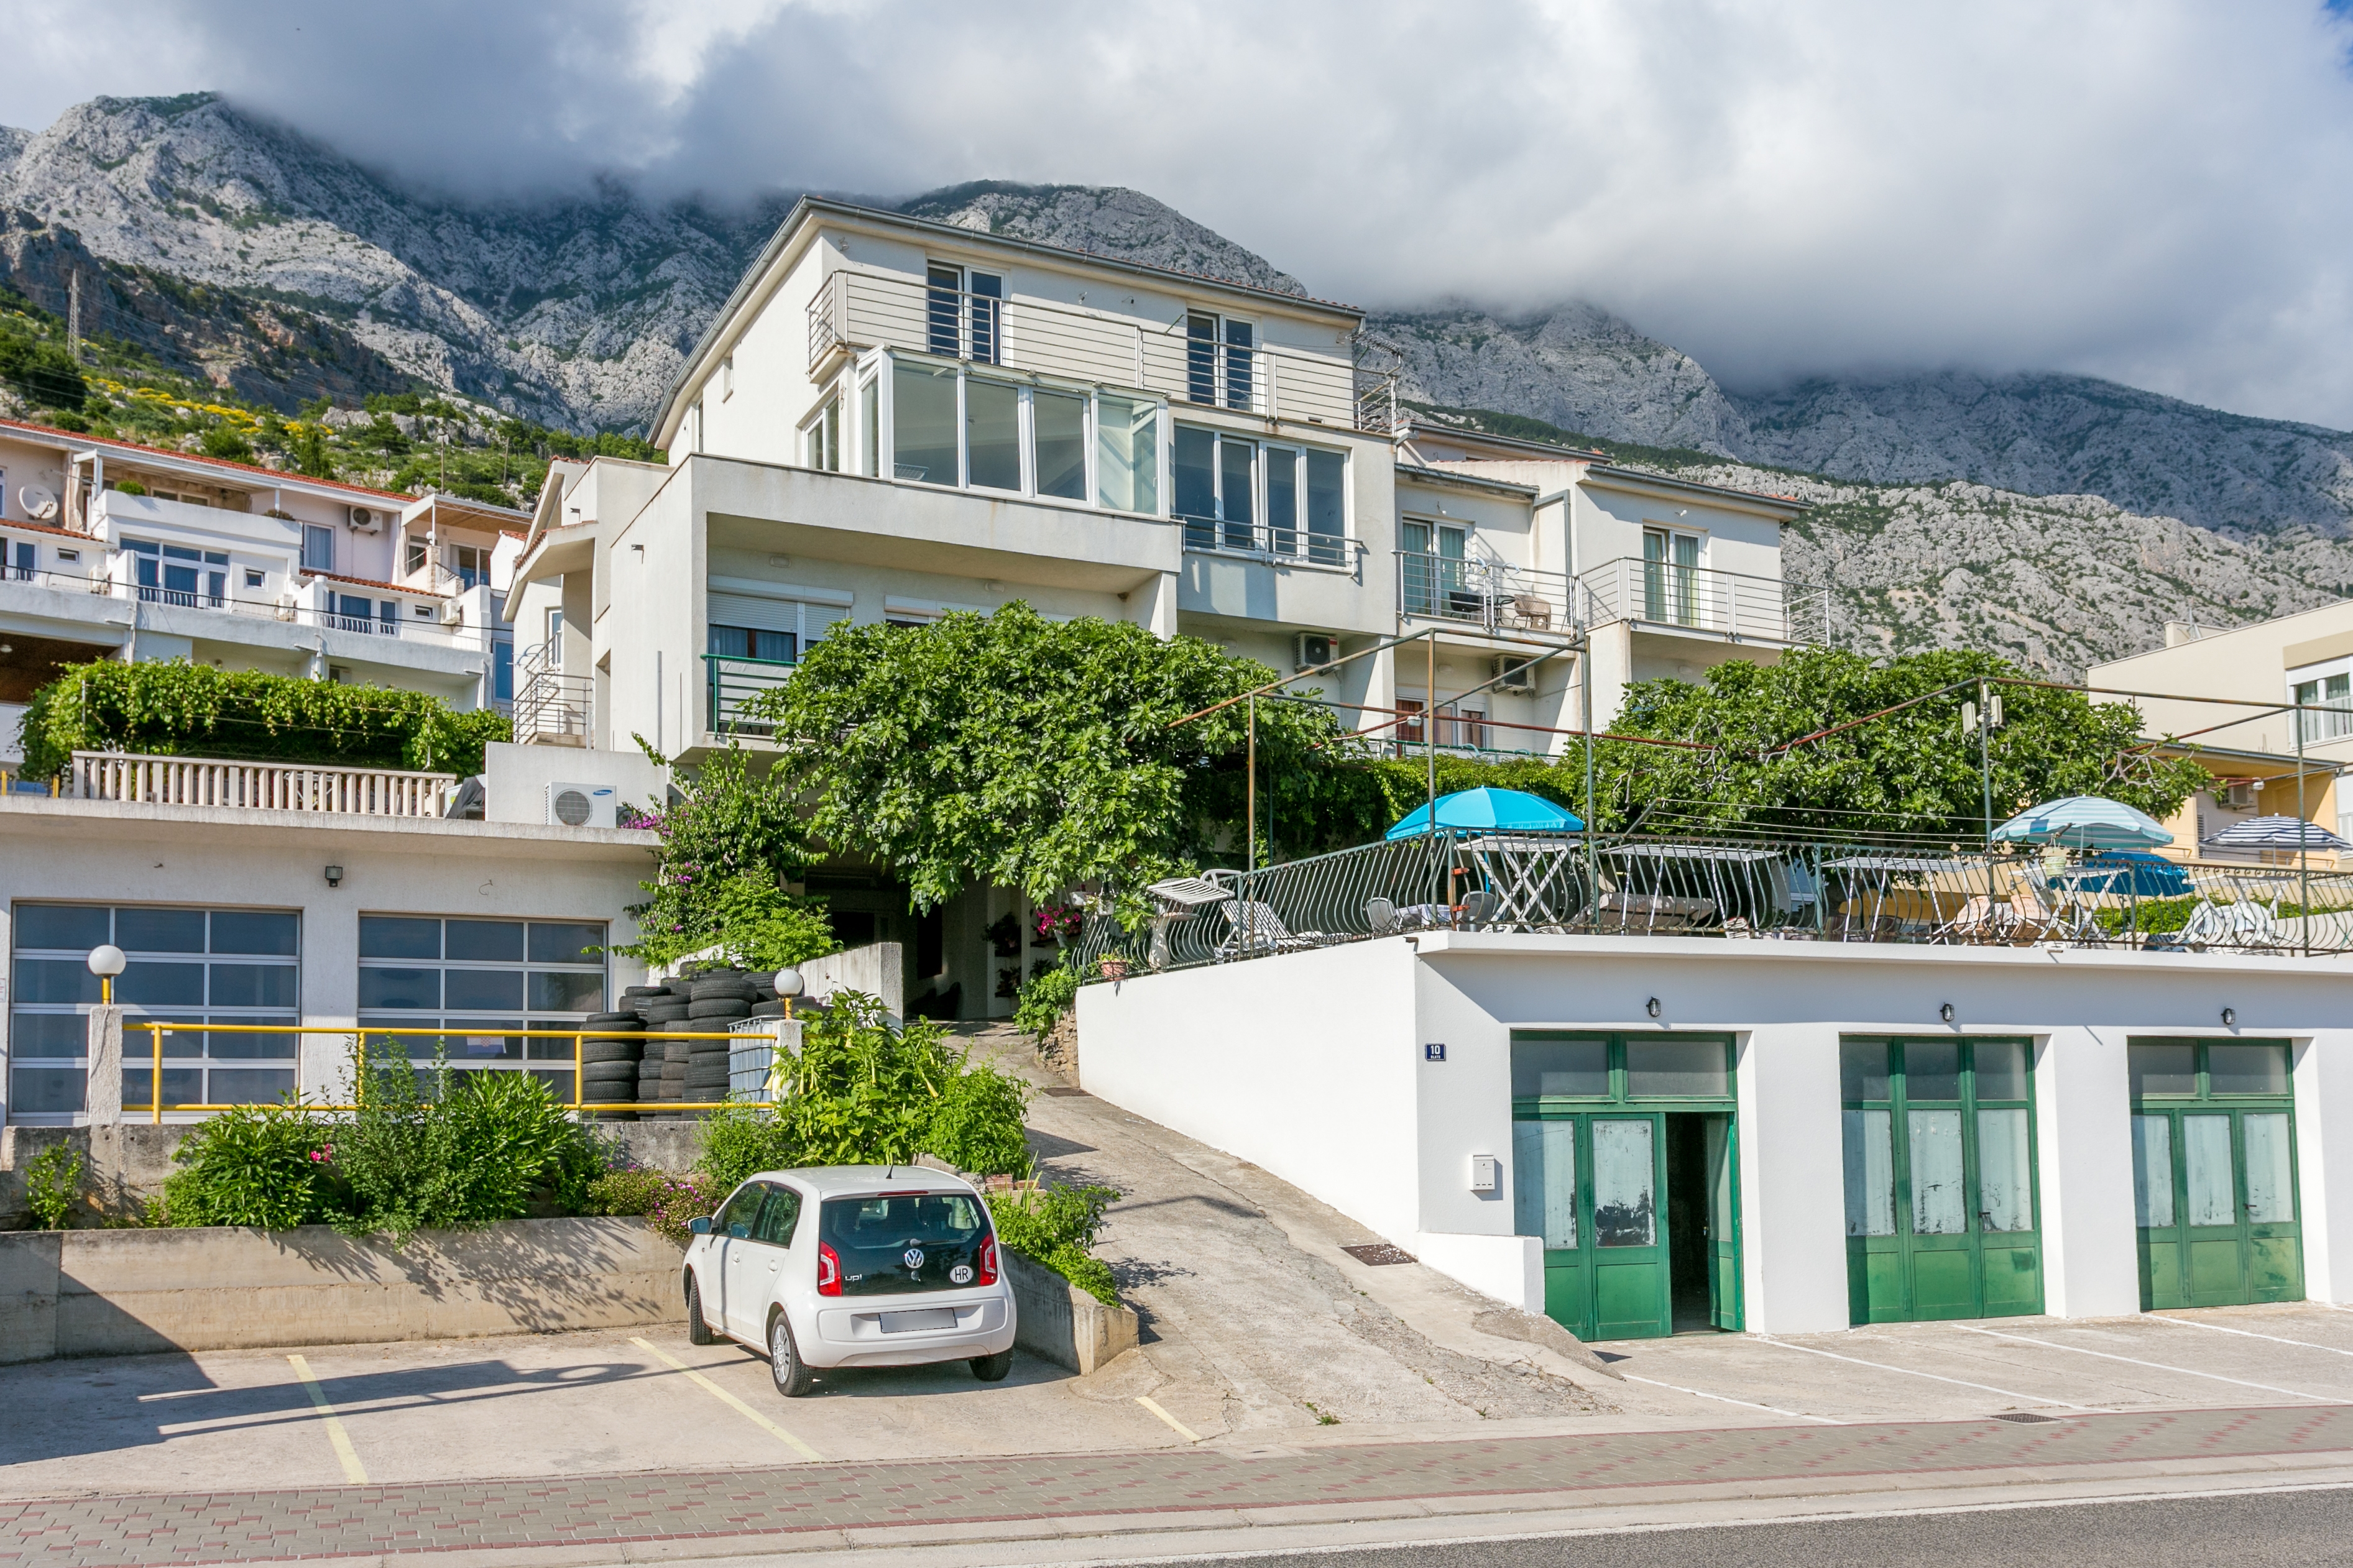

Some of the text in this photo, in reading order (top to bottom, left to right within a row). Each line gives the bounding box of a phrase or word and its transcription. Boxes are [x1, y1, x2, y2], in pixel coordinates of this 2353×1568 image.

[1430, 1045, 1440, 1055] 10
[905, 1249, 924, 1268] VW
[845, 1273, 862, 1282] up!
[954, 1268, 969, 1281] HR
